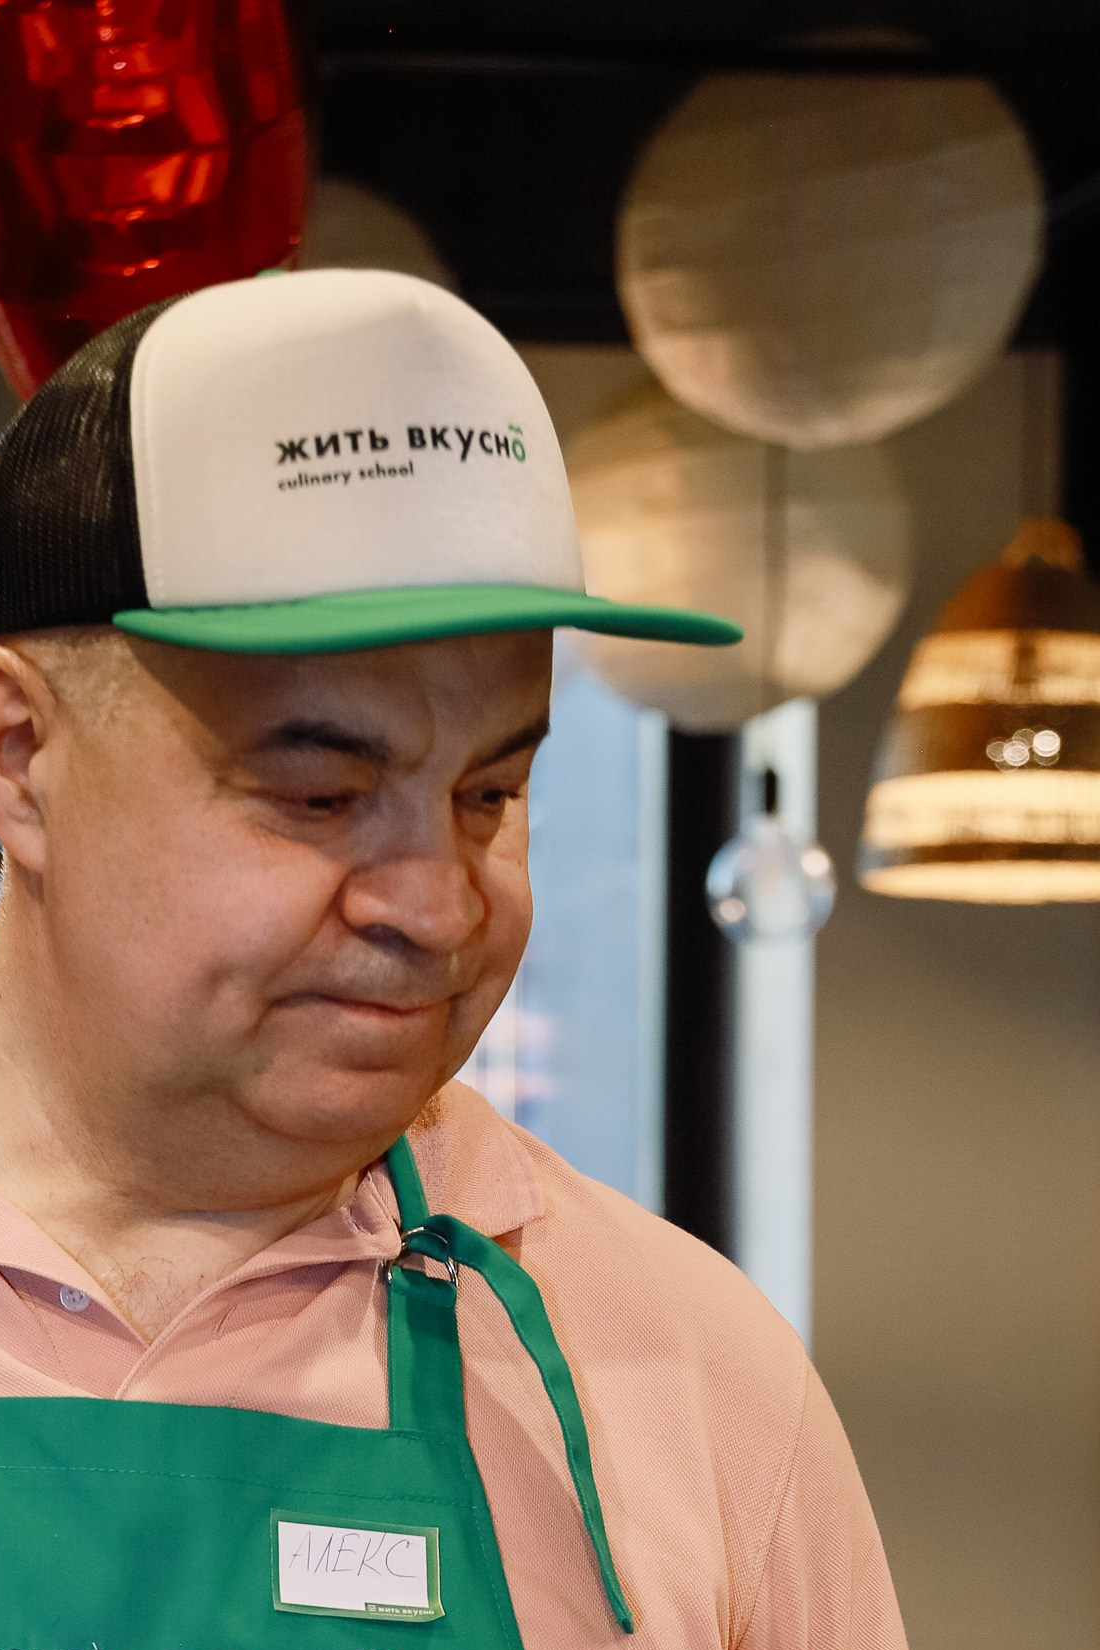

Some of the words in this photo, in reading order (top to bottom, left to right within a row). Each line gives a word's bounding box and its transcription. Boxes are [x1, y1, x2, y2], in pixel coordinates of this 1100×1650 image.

[278, 470, 351, 491] culinary
[359, 461, 414, 480] school
[289, 1531, 417, 1578] АЛЕКС
